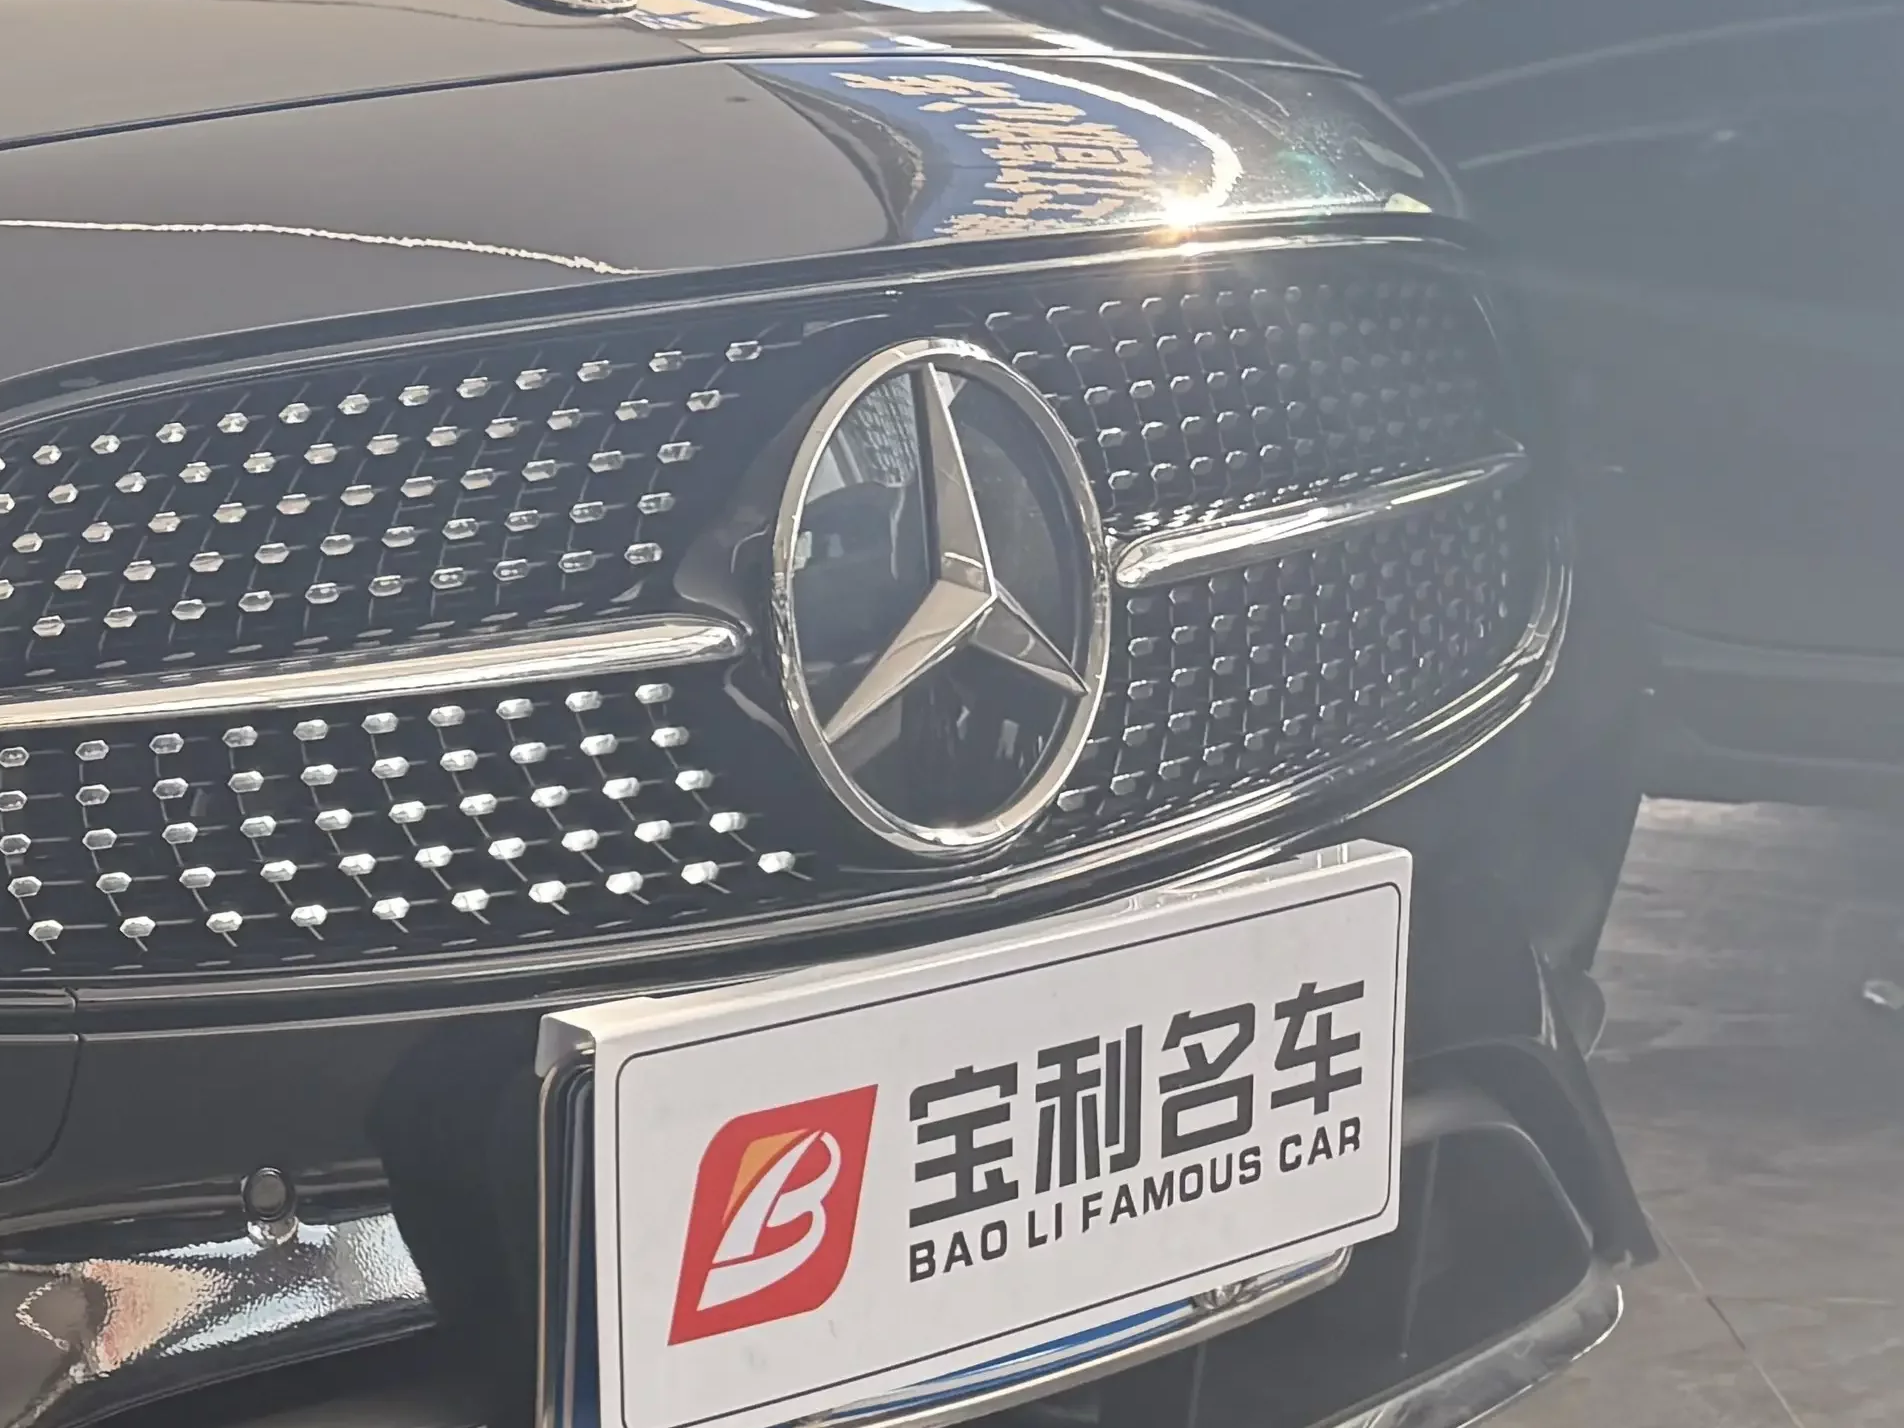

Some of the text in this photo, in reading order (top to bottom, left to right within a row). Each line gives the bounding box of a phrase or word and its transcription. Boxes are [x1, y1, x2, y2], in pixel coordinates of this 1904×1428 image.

[909, 979, 1365, 1229] 宝利名车
[909, 1116, 1362, 1283] BAO LI FAMOUS CAR
